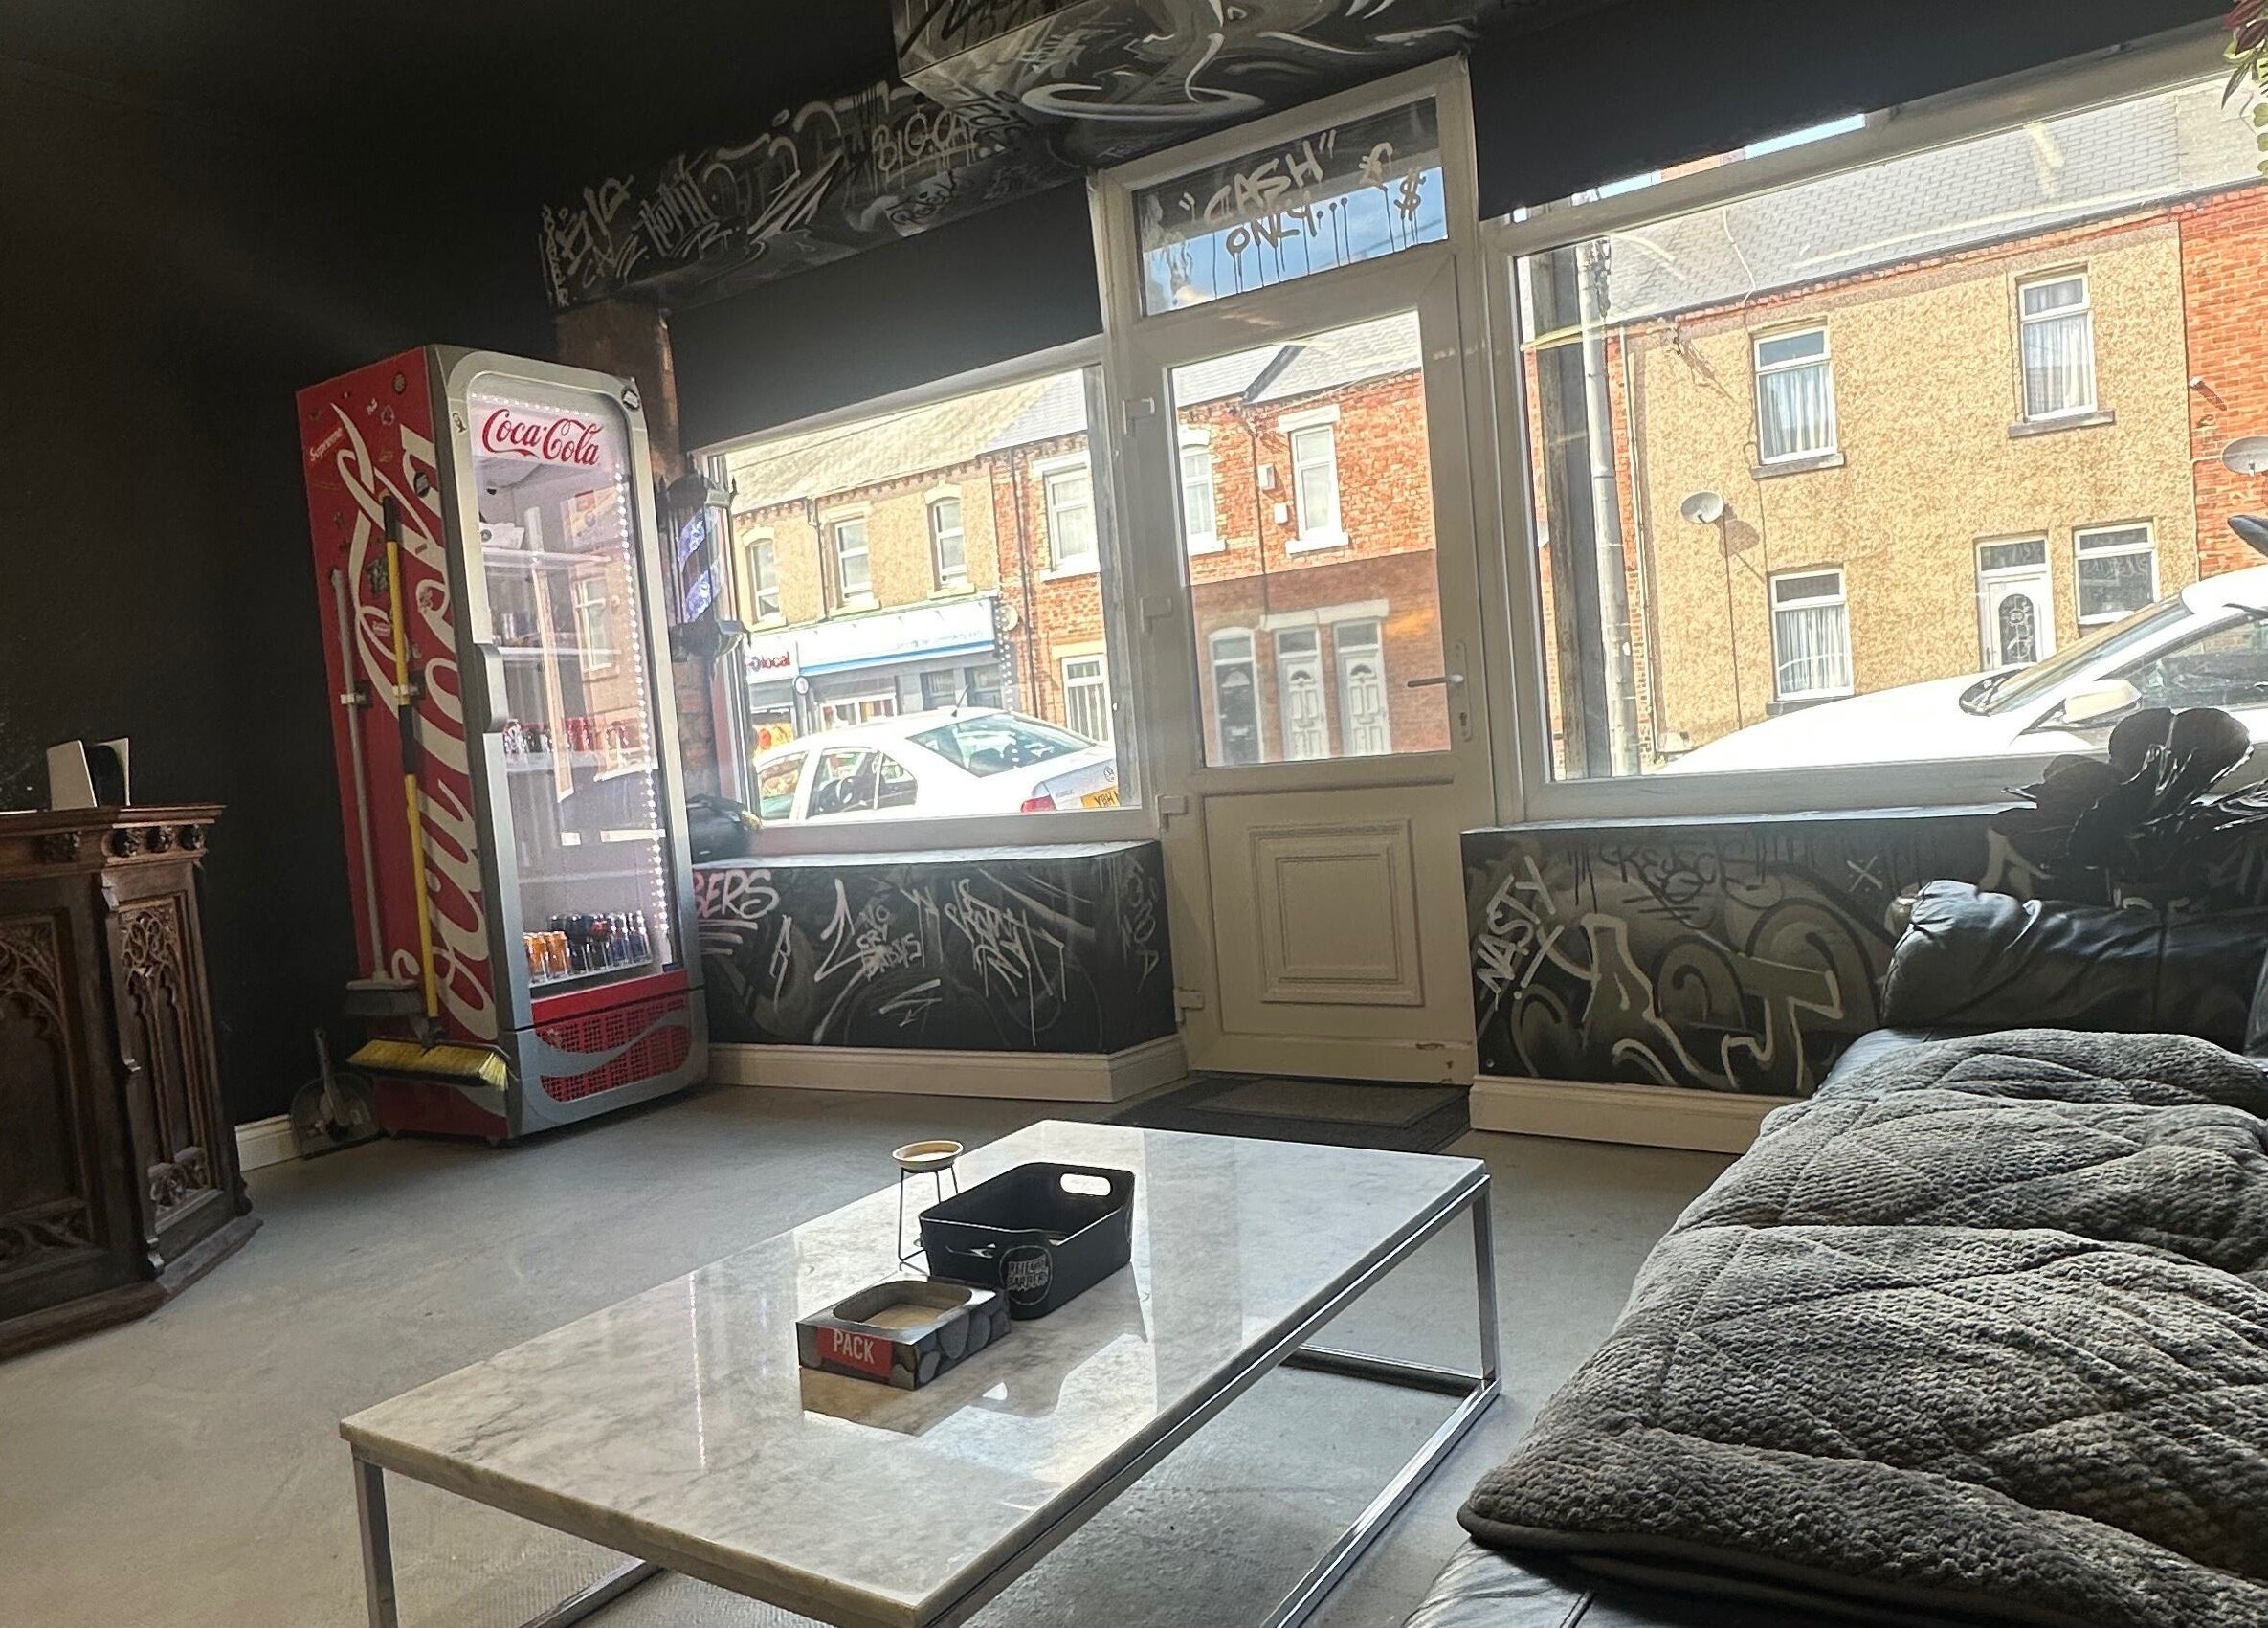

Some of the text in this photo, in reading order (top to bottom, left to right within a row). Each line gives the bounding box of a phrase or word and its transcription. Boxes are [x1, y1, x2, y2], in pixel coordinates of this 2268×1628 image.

[482, 408, 601, 466] Coca-Cola
[1477, 856, 1555, 995] NASTY
[833, 1330, 875, 1365] PACK
